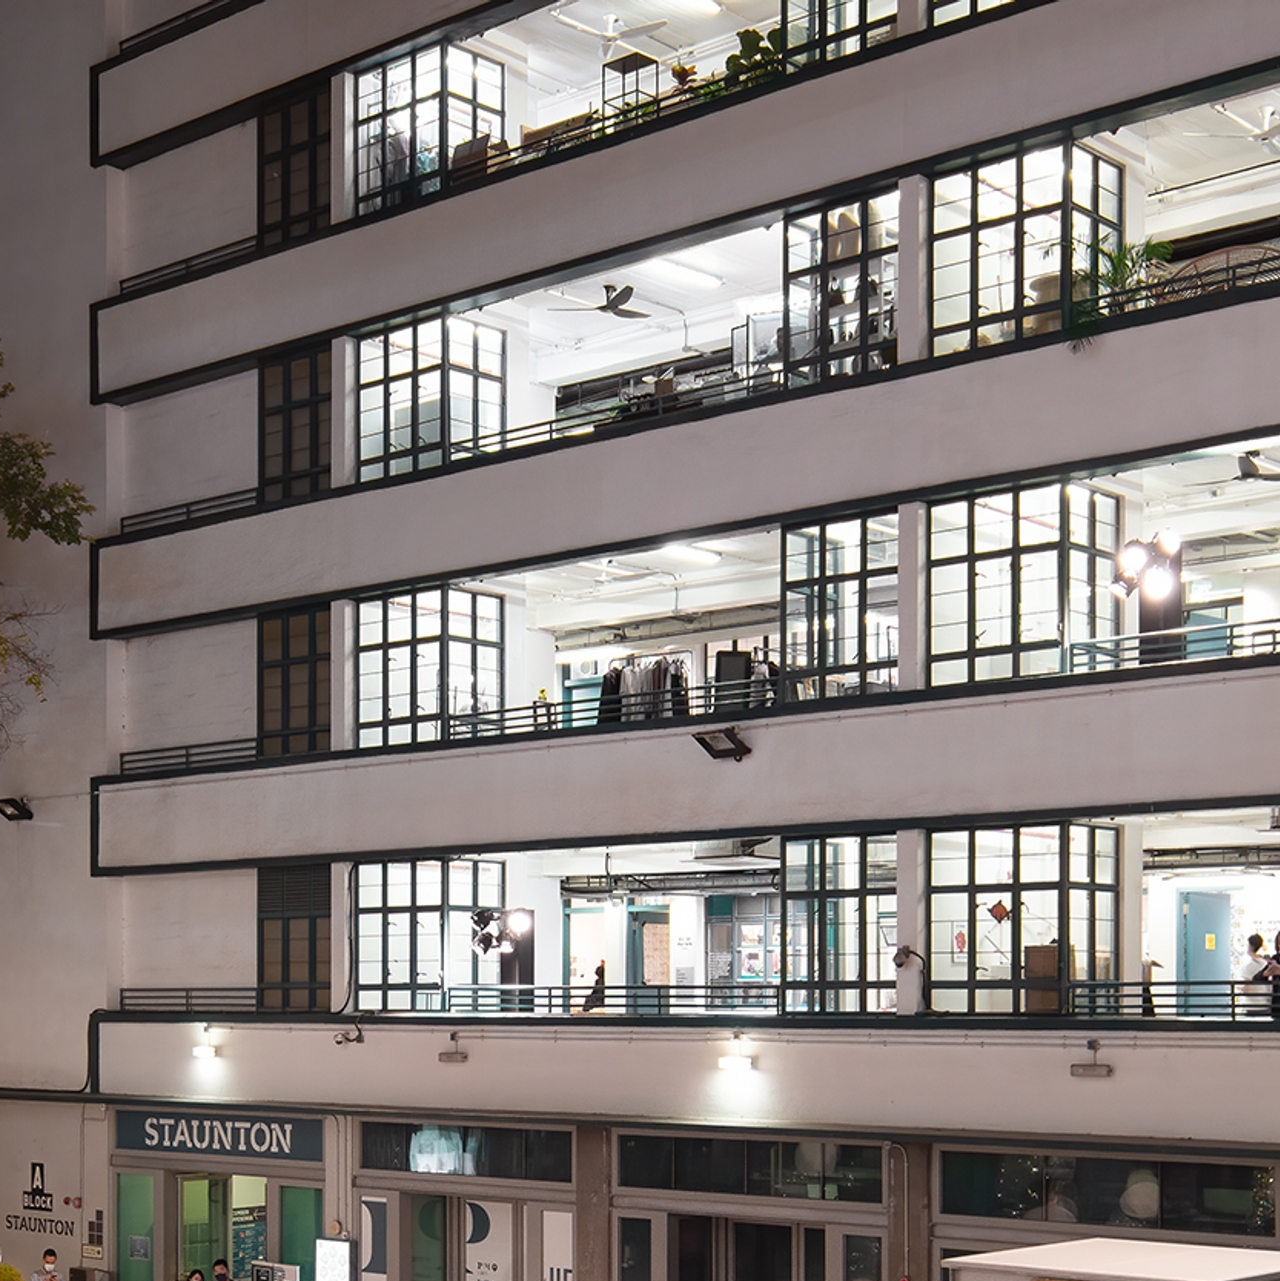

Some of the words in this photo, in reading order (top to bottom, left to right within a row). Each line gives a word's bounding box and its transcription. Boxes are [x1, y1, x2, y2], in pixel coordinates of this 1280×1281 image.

[144, 1116, 293, 1154] STAUNTON
[33, 1165, 43, 1190] A
[23, 1193, 52, 1209] BLOCK
[5, 1214, 75, 1236] STAUNTON
